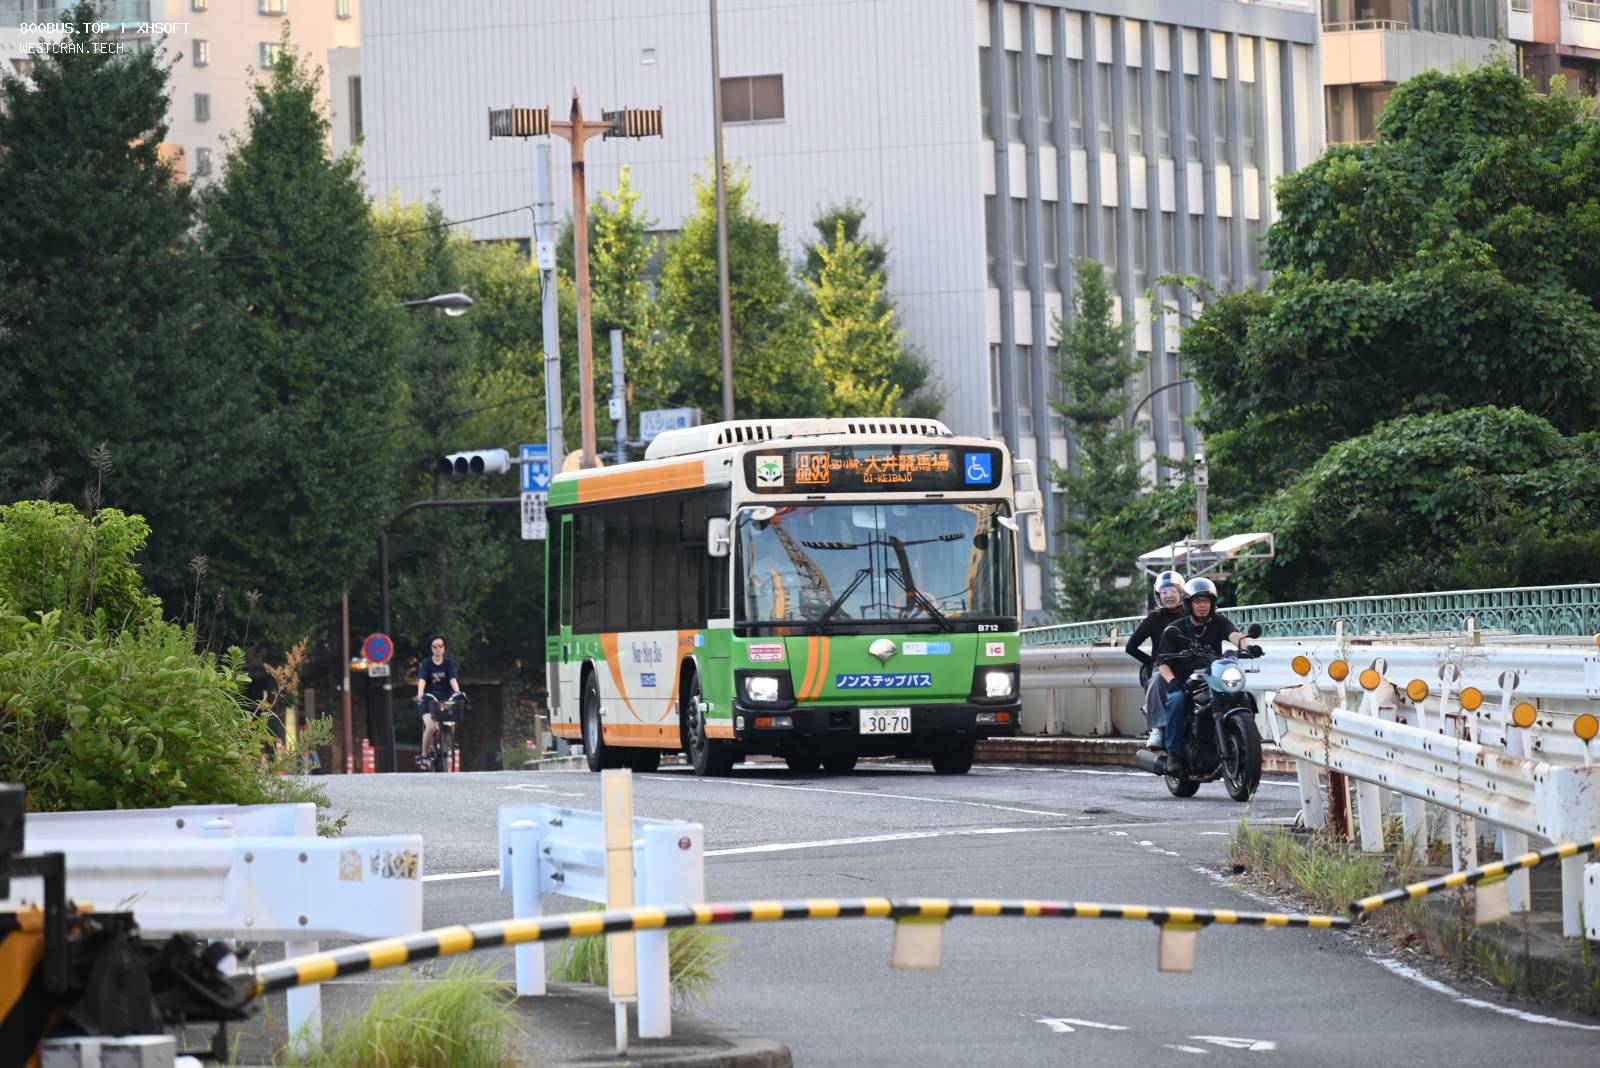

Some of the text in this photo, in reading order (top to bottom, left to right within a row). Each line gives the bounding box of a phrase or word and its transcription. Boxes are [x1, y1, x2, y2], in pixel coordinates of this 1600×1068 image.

[864, 454, 950, 472] 大井競馬場
[977, 624, 999, 632] B712
[837, 674, 931, 687] ノンステップバス
